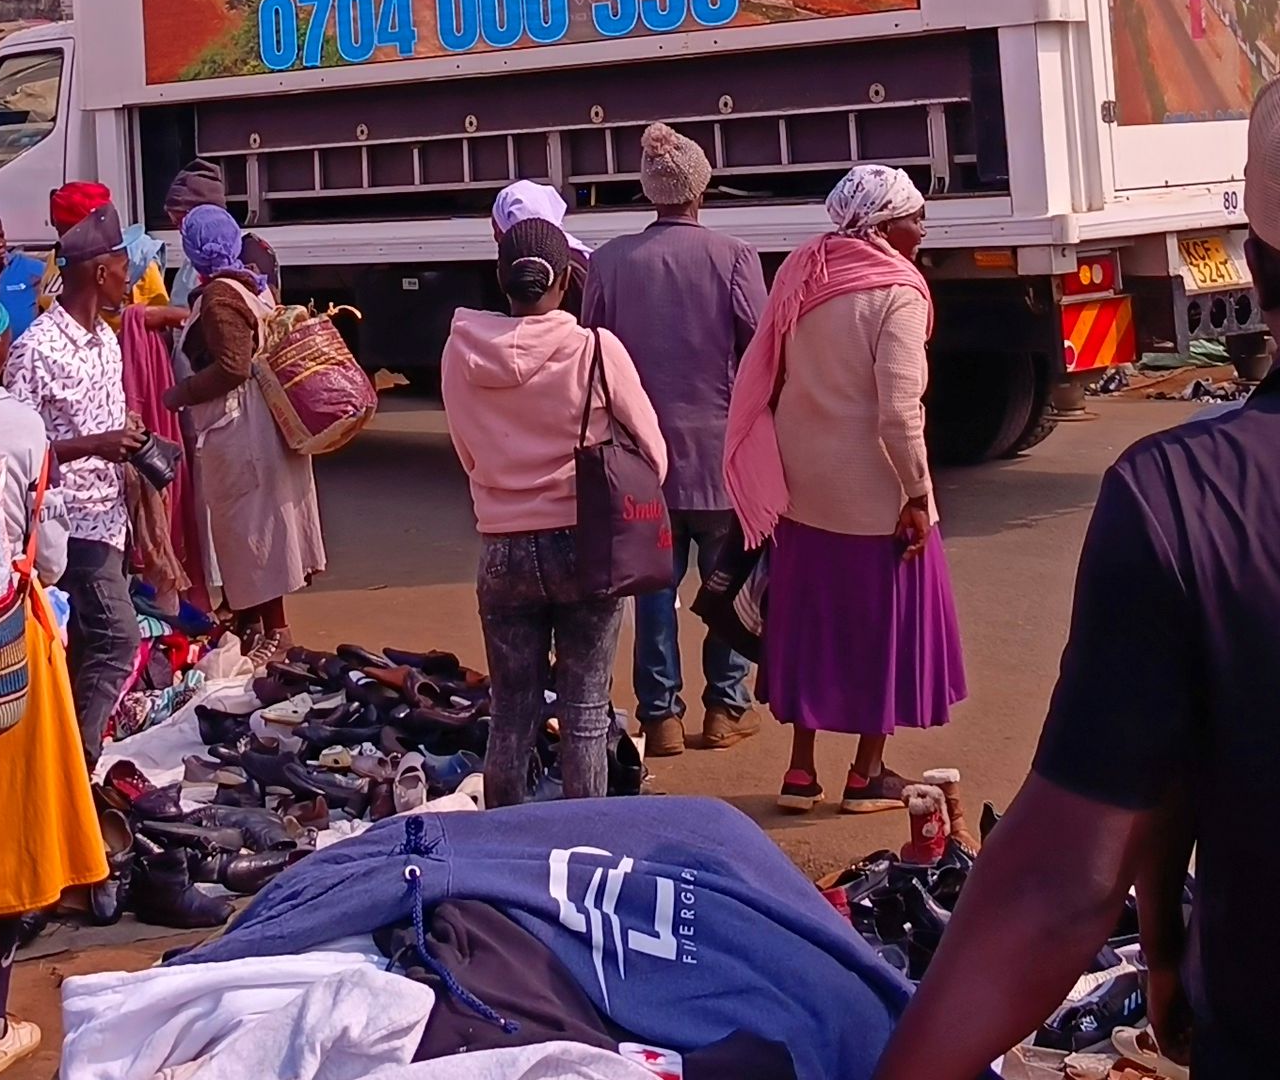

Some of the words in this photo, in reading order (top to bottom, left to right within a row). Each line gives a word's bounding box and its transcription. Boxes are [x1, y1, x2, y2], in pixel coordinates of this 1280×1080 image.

[1223, 190, 1238, 210] 80
[1180, 239, 1212, 262] KCF
[1189, 259, 1233, 283] 324T
